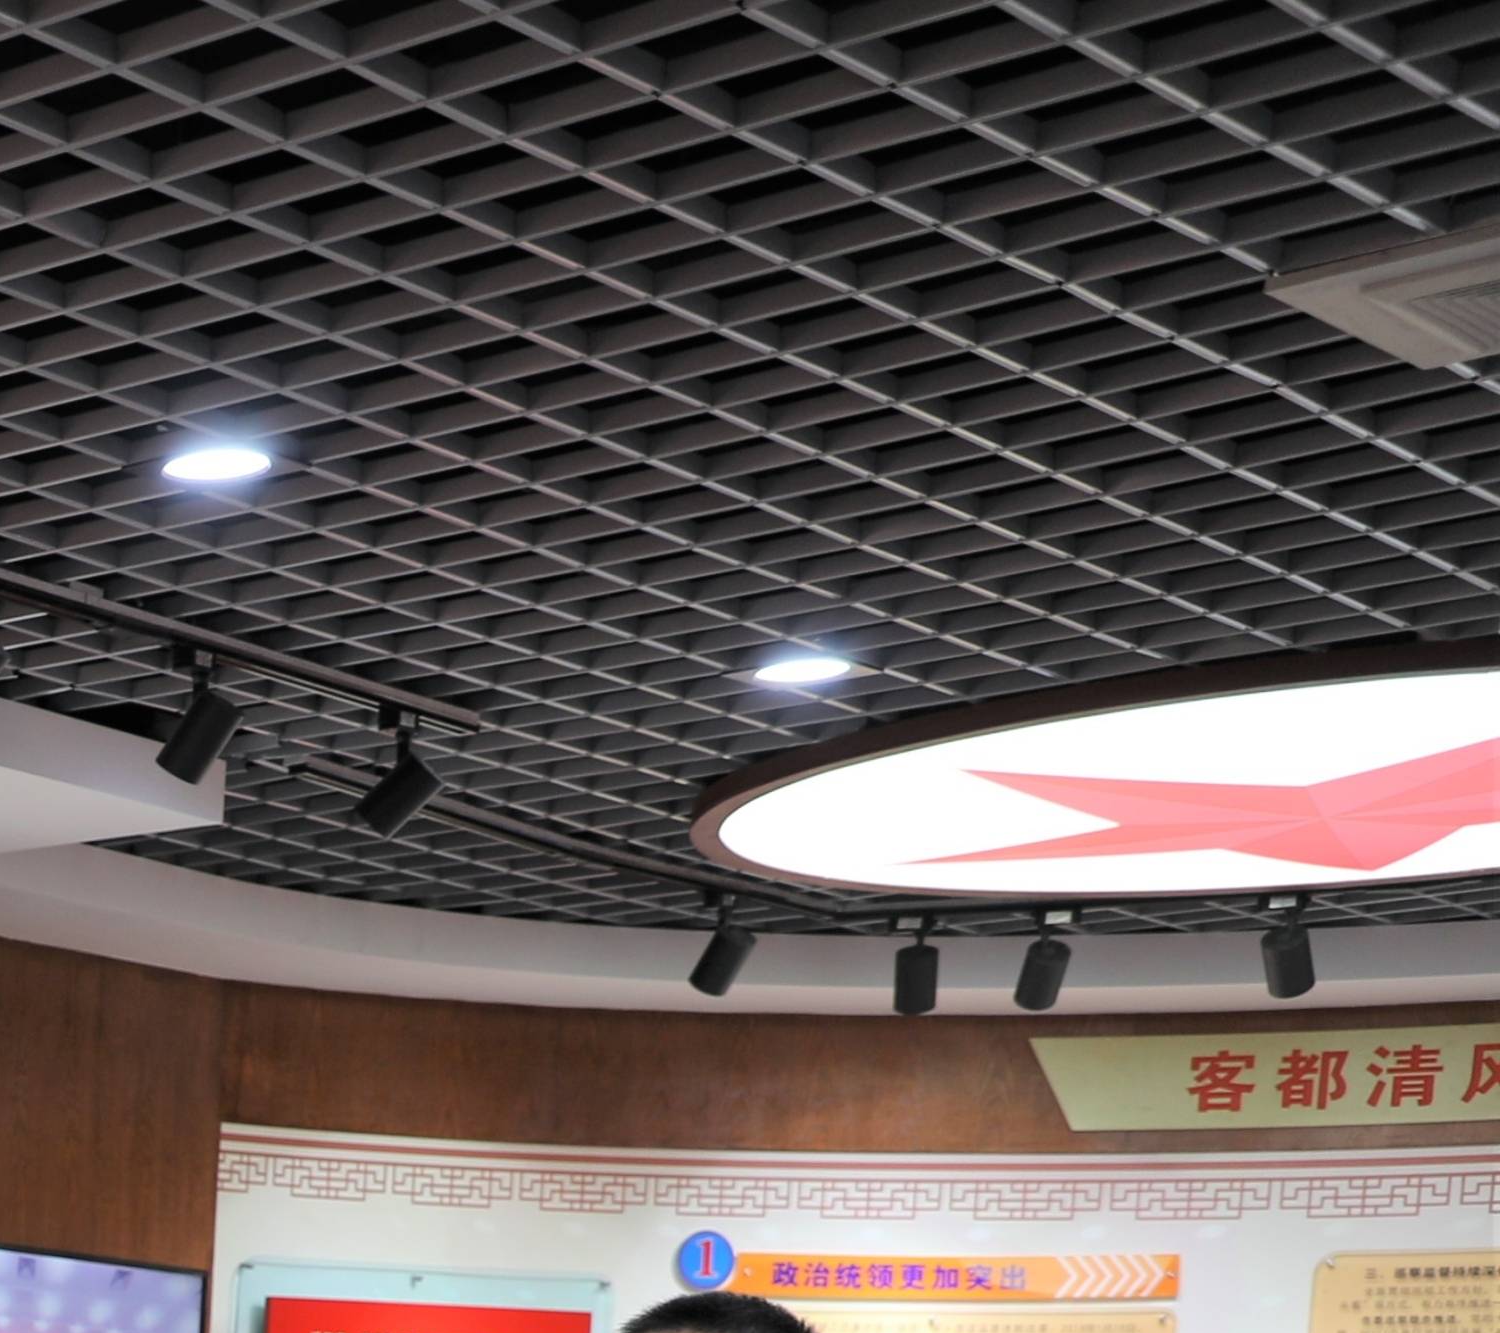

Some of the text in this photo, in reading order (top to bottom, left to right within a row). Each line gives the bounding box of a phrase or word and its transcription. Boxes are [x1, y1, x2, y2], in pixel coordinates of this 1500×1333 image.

[695, 1237, 1029, 1292] 1 政治统领更加突出
